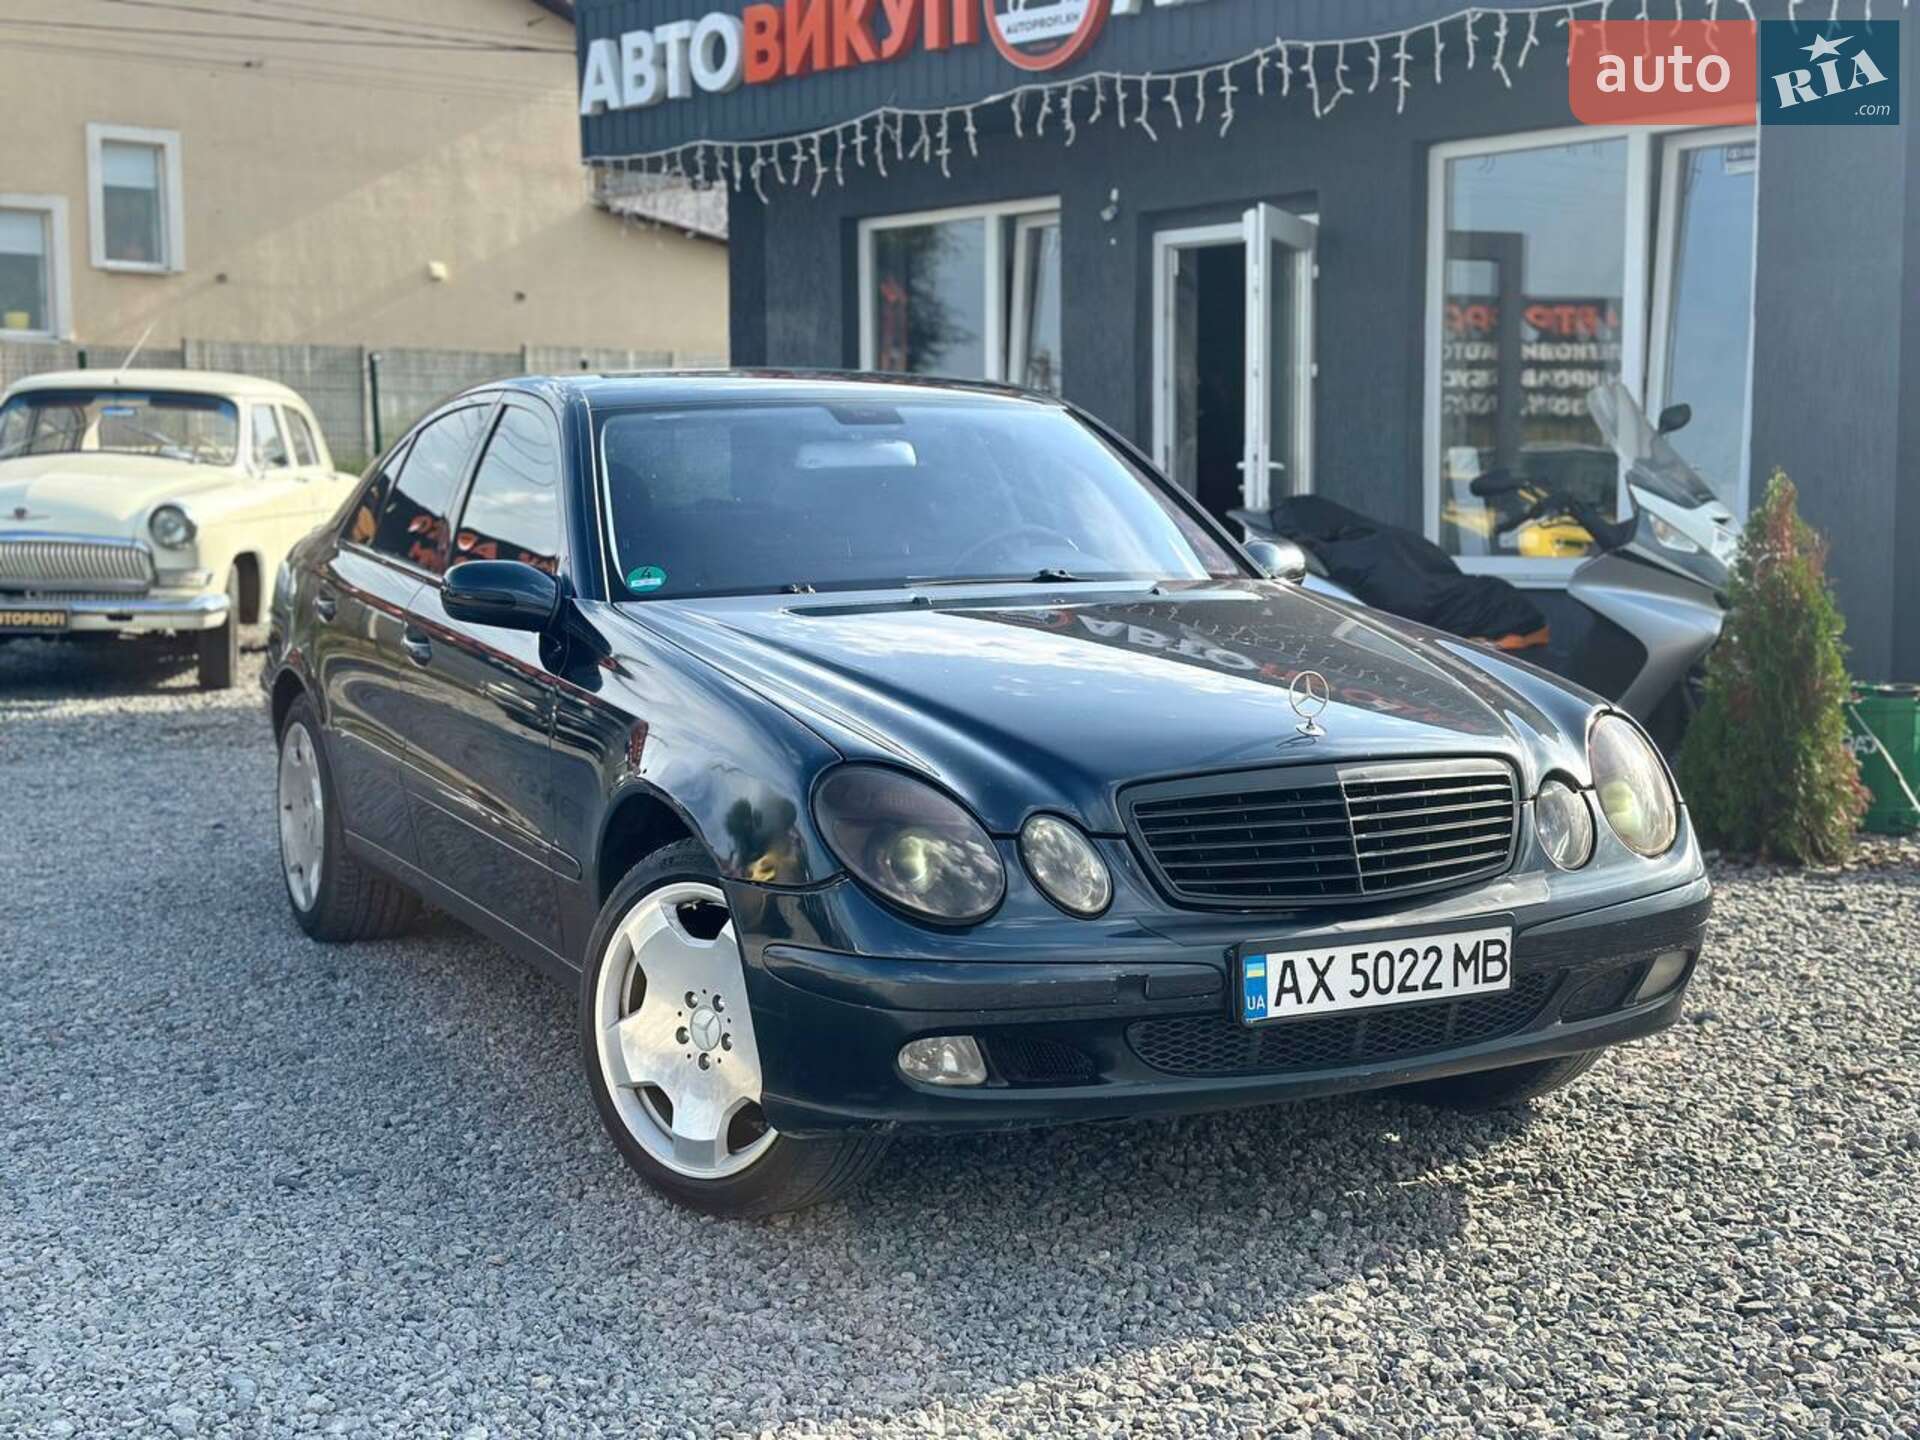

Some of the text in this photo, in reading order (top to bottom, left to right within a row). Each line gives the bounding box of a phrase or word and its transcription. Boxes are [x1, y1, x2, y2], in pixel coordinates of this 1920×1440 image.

[641, 567, 652, 579] 4
[1274, 938, 1508, 1007] AX 5022 MB
[1247, 994, 1266, 1011] UA
